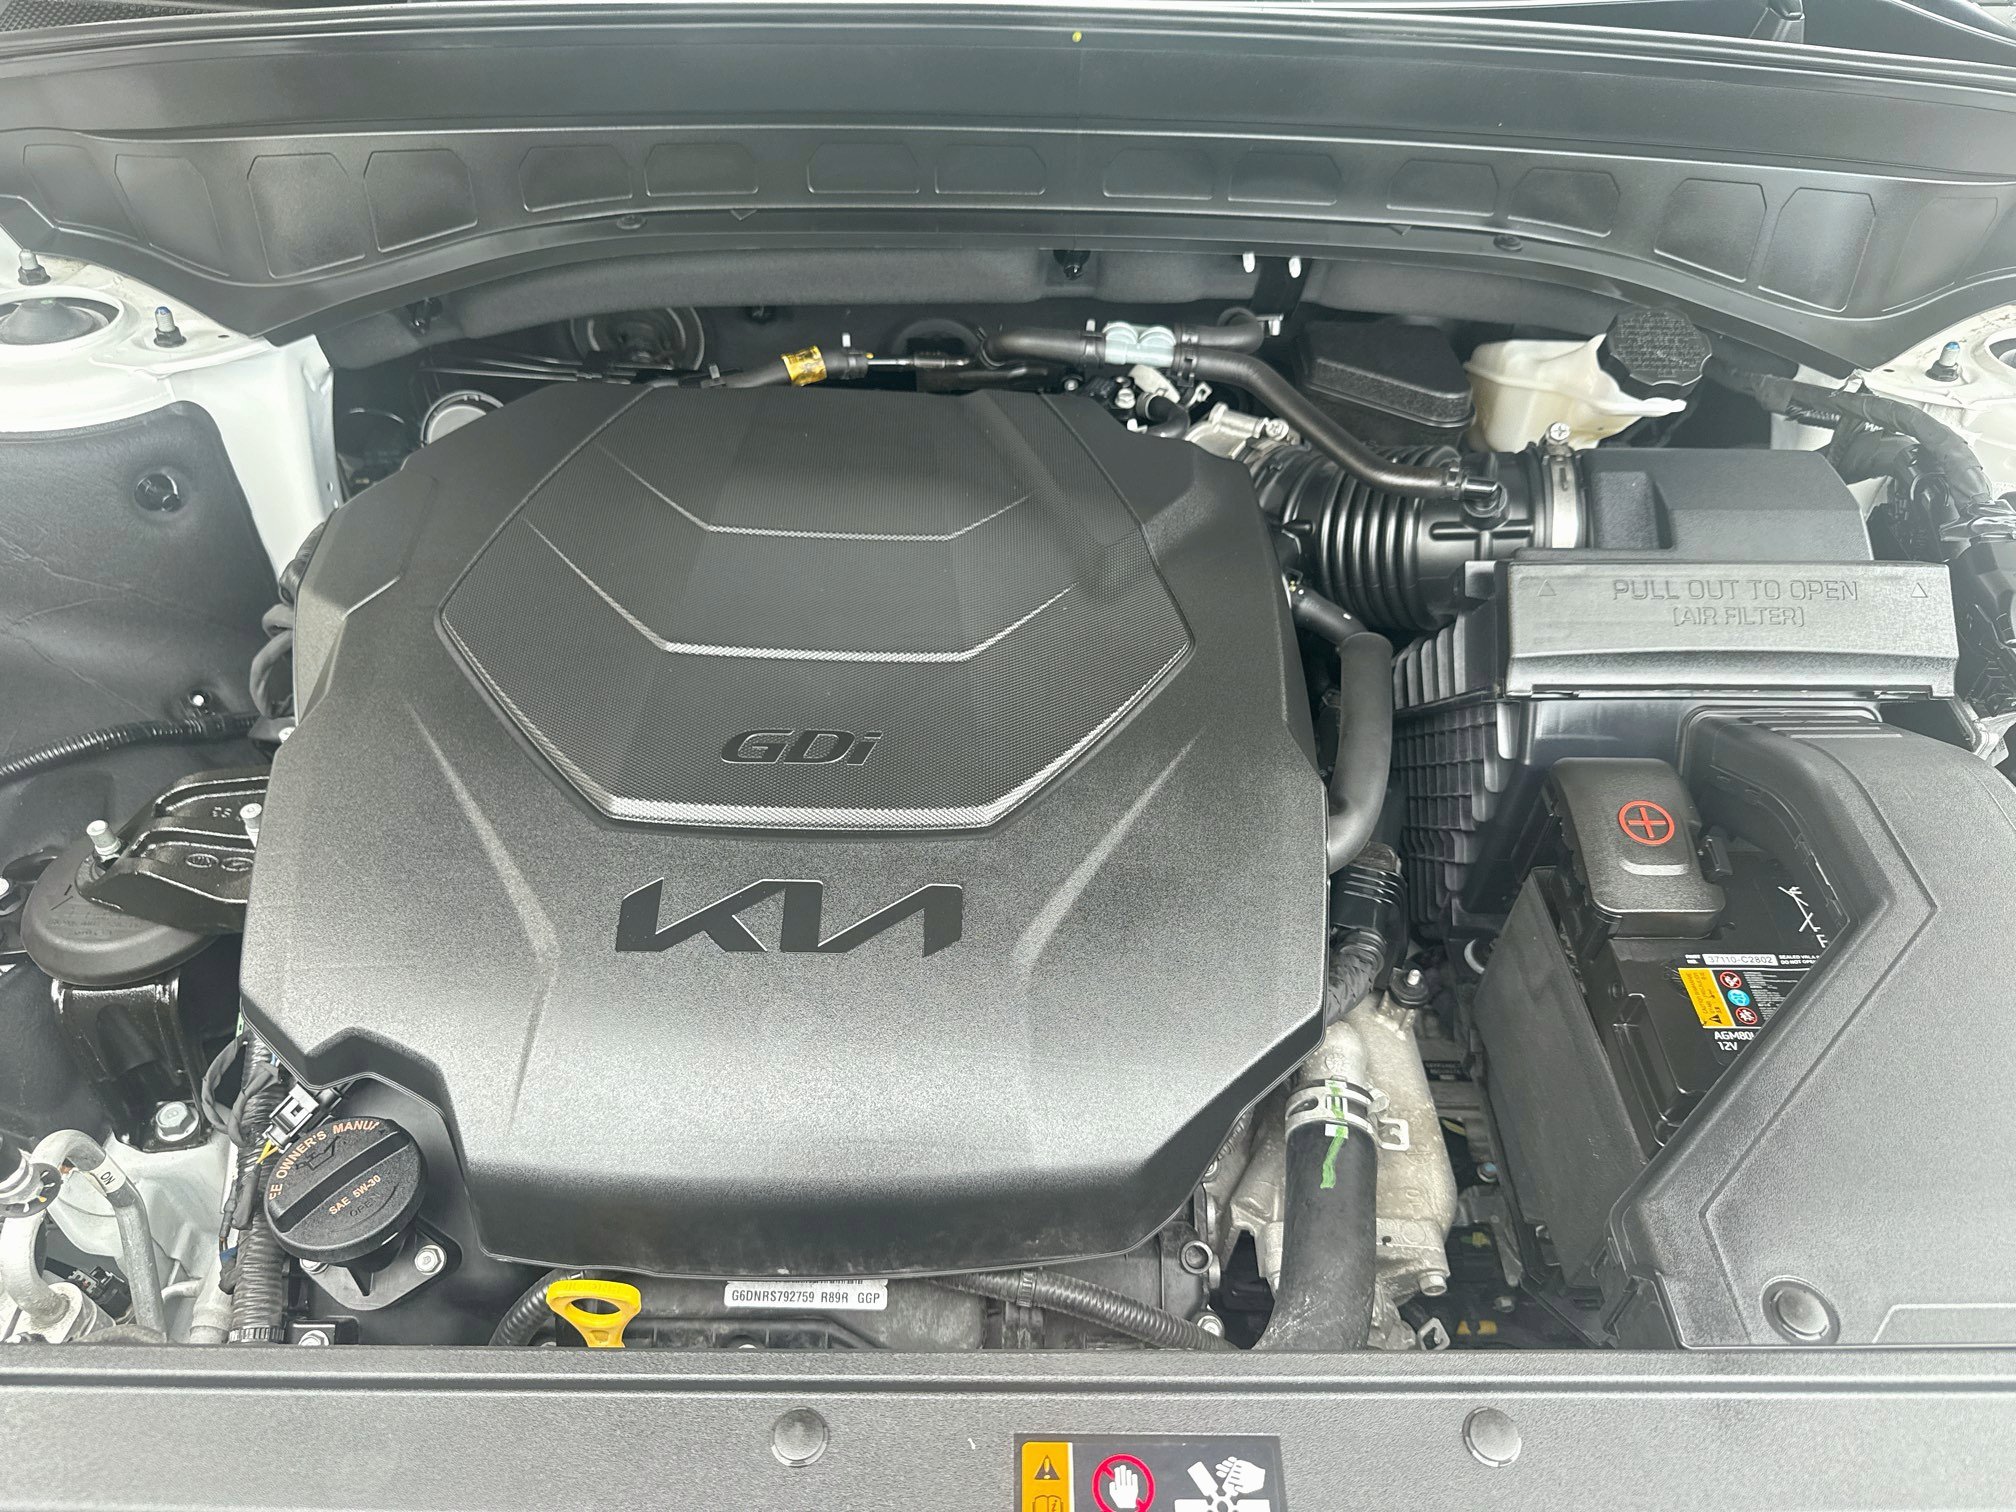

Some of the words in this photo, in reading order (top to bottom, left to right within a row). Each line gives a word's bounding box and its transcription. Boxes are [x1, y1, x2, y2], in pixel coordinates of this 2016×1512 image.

[1612, 579, 1680, 600] PULL
[1687, 579, 1739, 600] OUT
[1749, 579, 1781, 600] TO
[1789, 580, 1858, 601] OPEN
[720, 728, 883, 766] GDi
[1707, 956, 1773, 964] 37110-C2802
[1717, 1041, 1738, 1051] 12V
[276, 1130, 327, 1179] OWNER'S
[328, 1196, 351, 1215] SAE
[352, 1174, 381, 1198] 5W-30
[731, 1289, 815, 1303] G6DNRS792759
[857, 1292, 880, 1304] GGP
